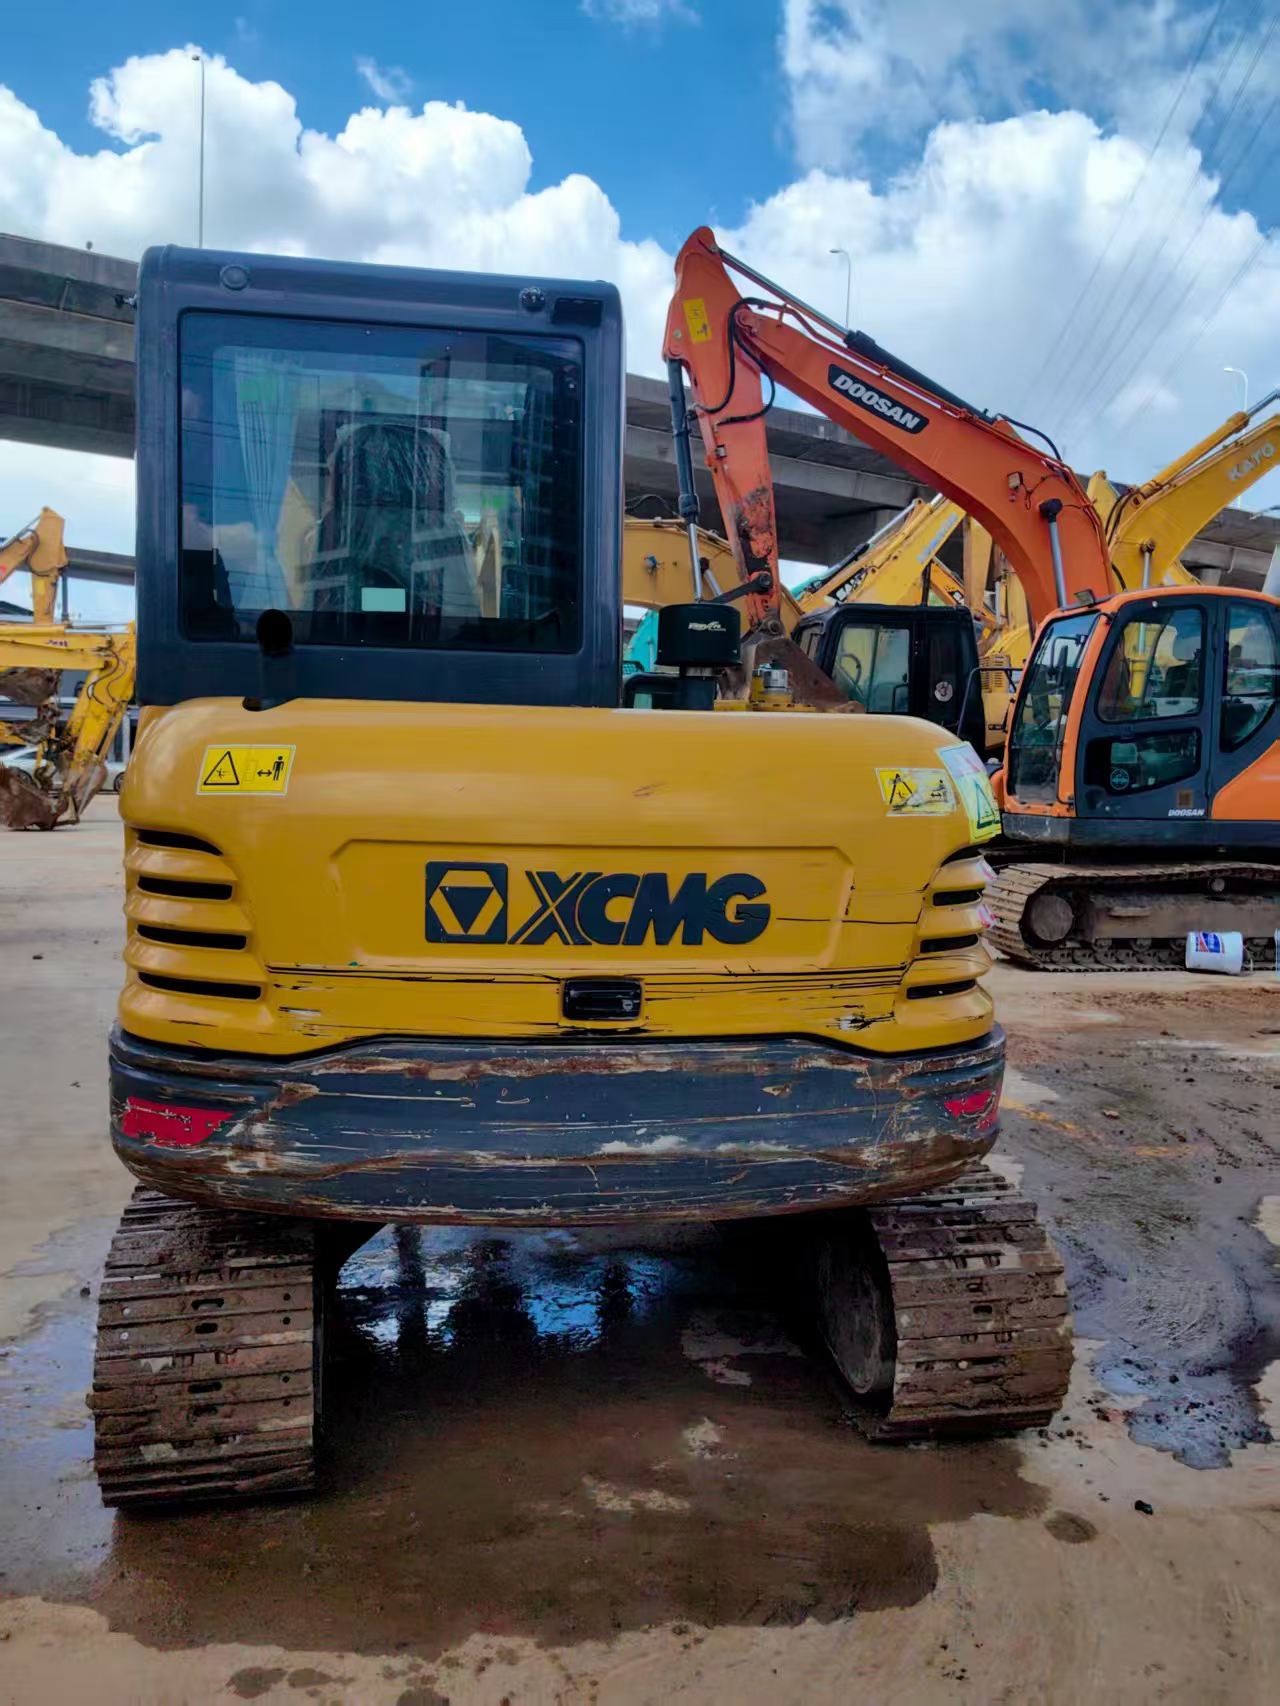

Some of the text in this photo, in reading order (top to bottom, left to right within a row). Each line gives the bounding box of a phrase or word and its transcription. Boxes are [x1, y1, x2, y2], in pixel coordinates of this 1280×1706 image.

[833, 374, 920, 430] DOOSAN
[1168, 808, 1205, 817] DOOSAN
[507, 871, 771, 946] XCMG
